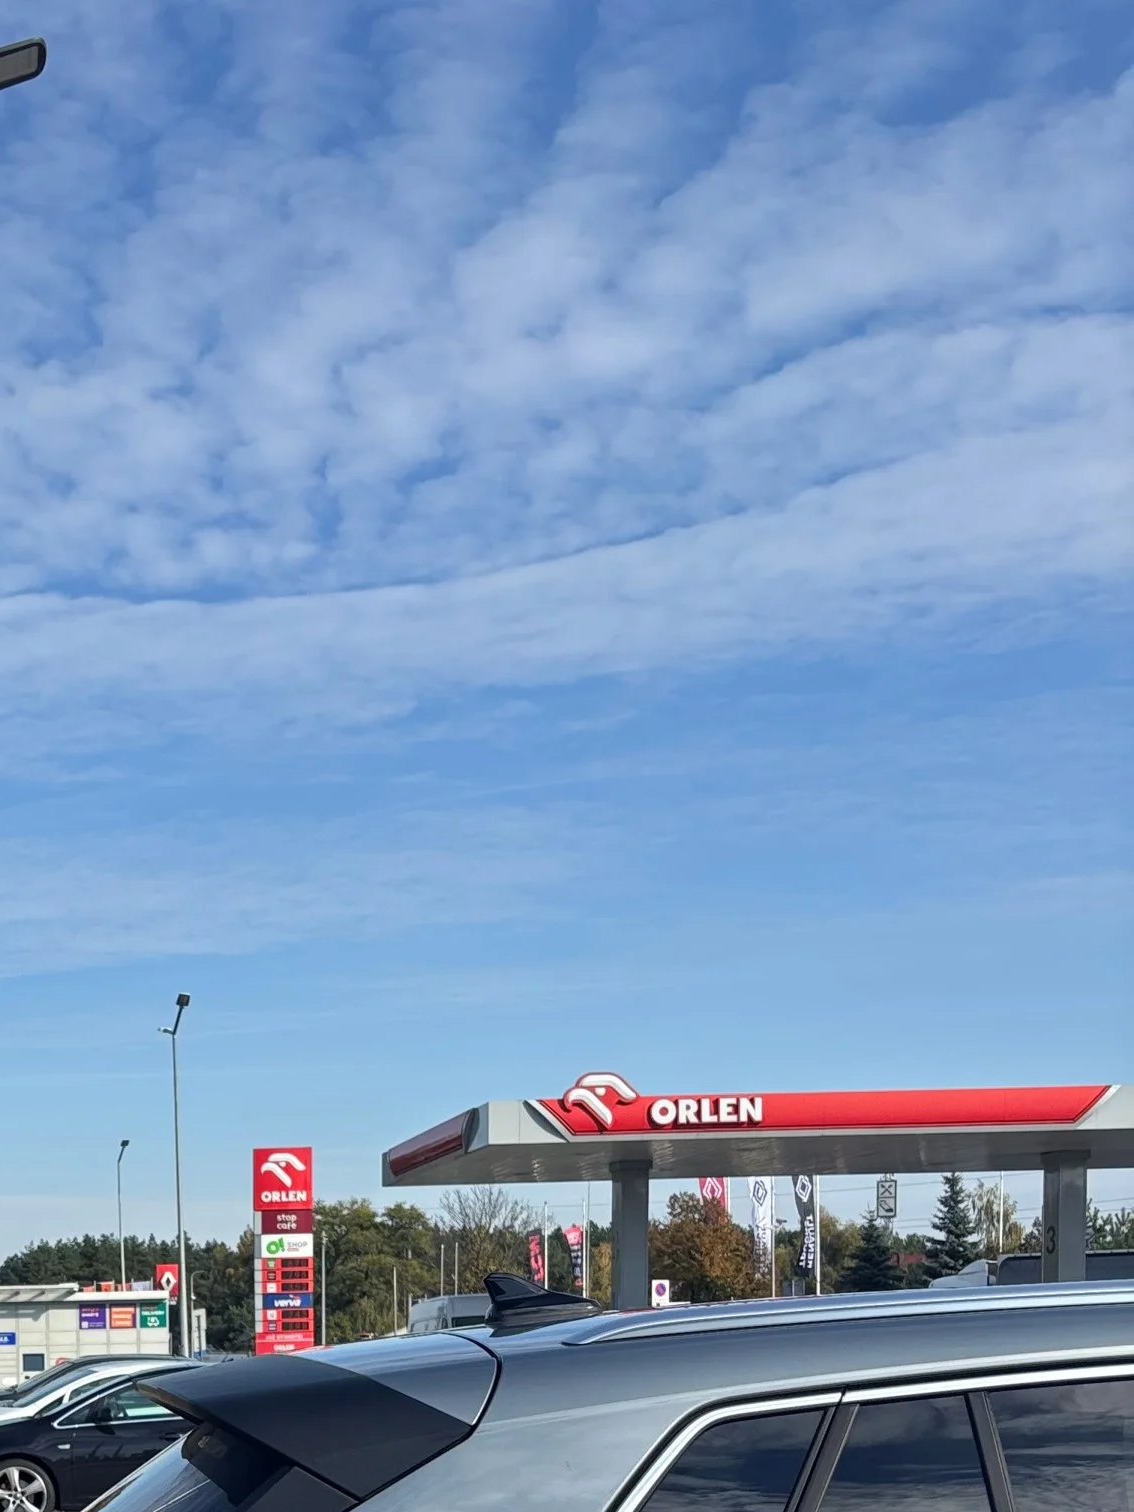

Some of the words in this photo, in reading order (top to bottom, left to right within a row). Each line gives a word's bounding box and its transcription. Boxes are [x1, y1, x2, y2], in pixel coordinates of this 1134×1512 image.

[649, 1096, 763, 1126] ORLEN
[260, 1190, 308, 1203] ORLEN
[276, 1213, 297, 1222] stop
[276, 1222, 297, 1230] cafe
[1046, 1225, 1056, 1255] 3
